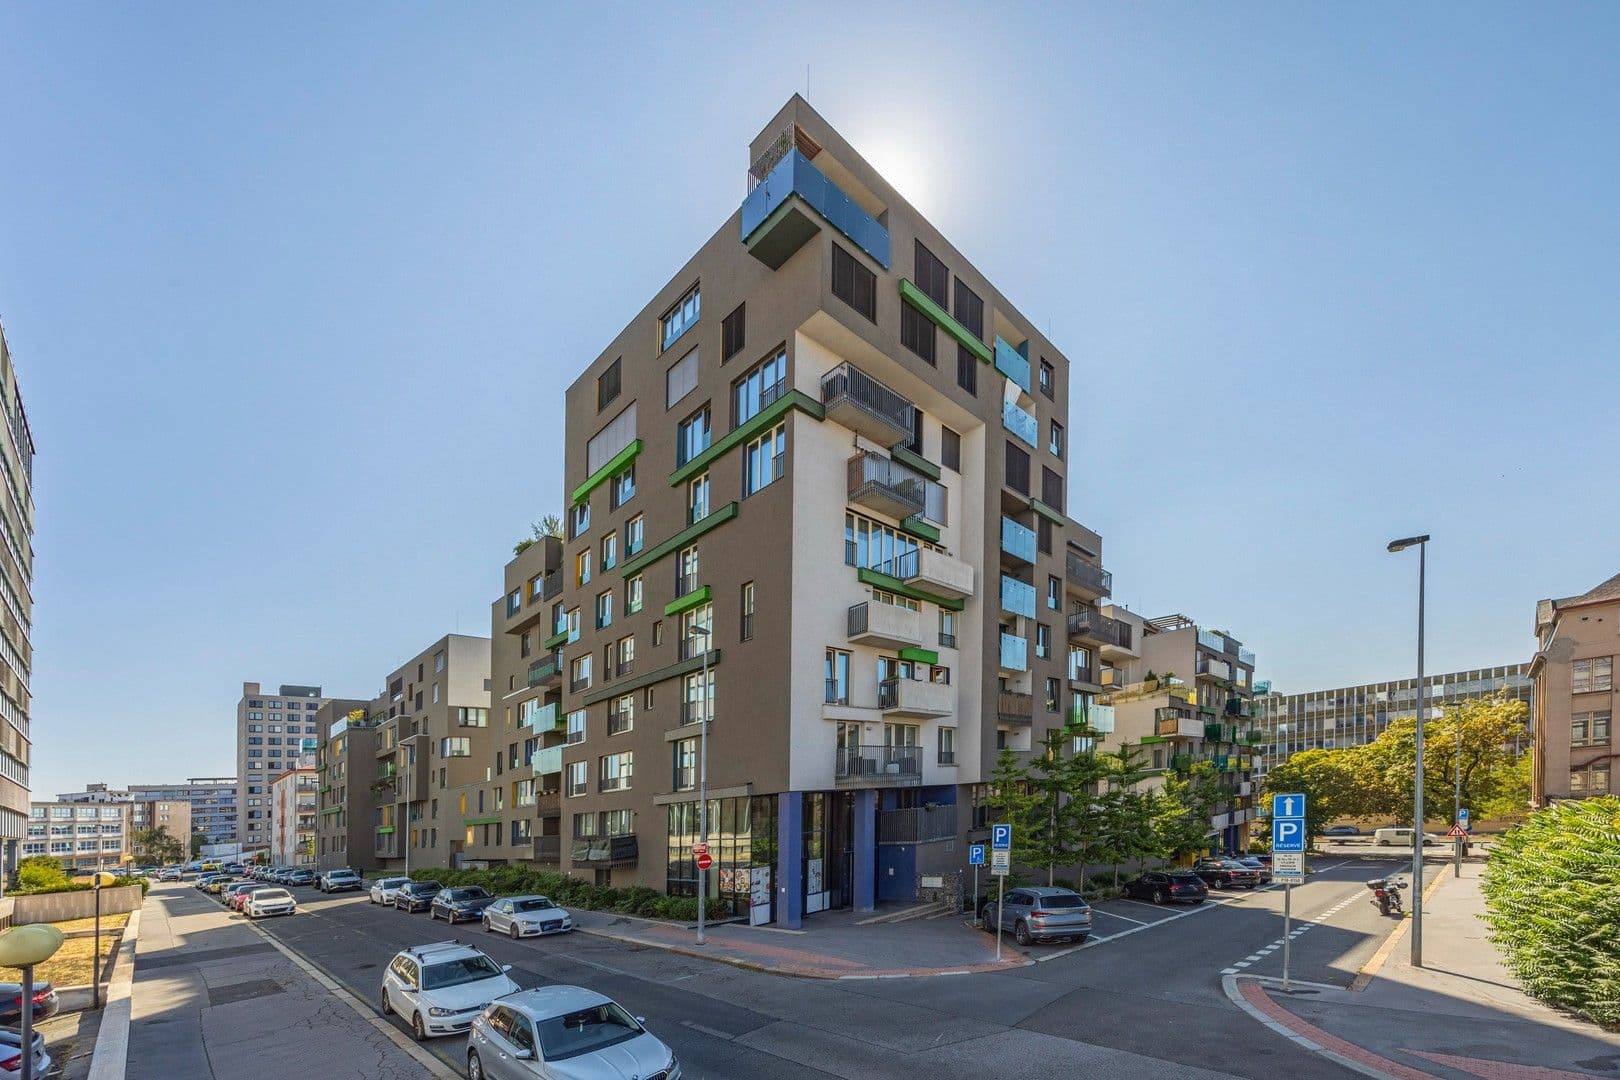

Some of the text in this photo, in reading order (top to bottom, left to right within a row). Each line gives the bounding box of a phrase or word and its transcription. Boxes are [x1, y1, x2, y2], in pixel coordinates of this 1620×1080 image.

[996, 828, 1007, 842] P
[1279, 822, 1298, 841] P
[972, 847, 982, 858] P
